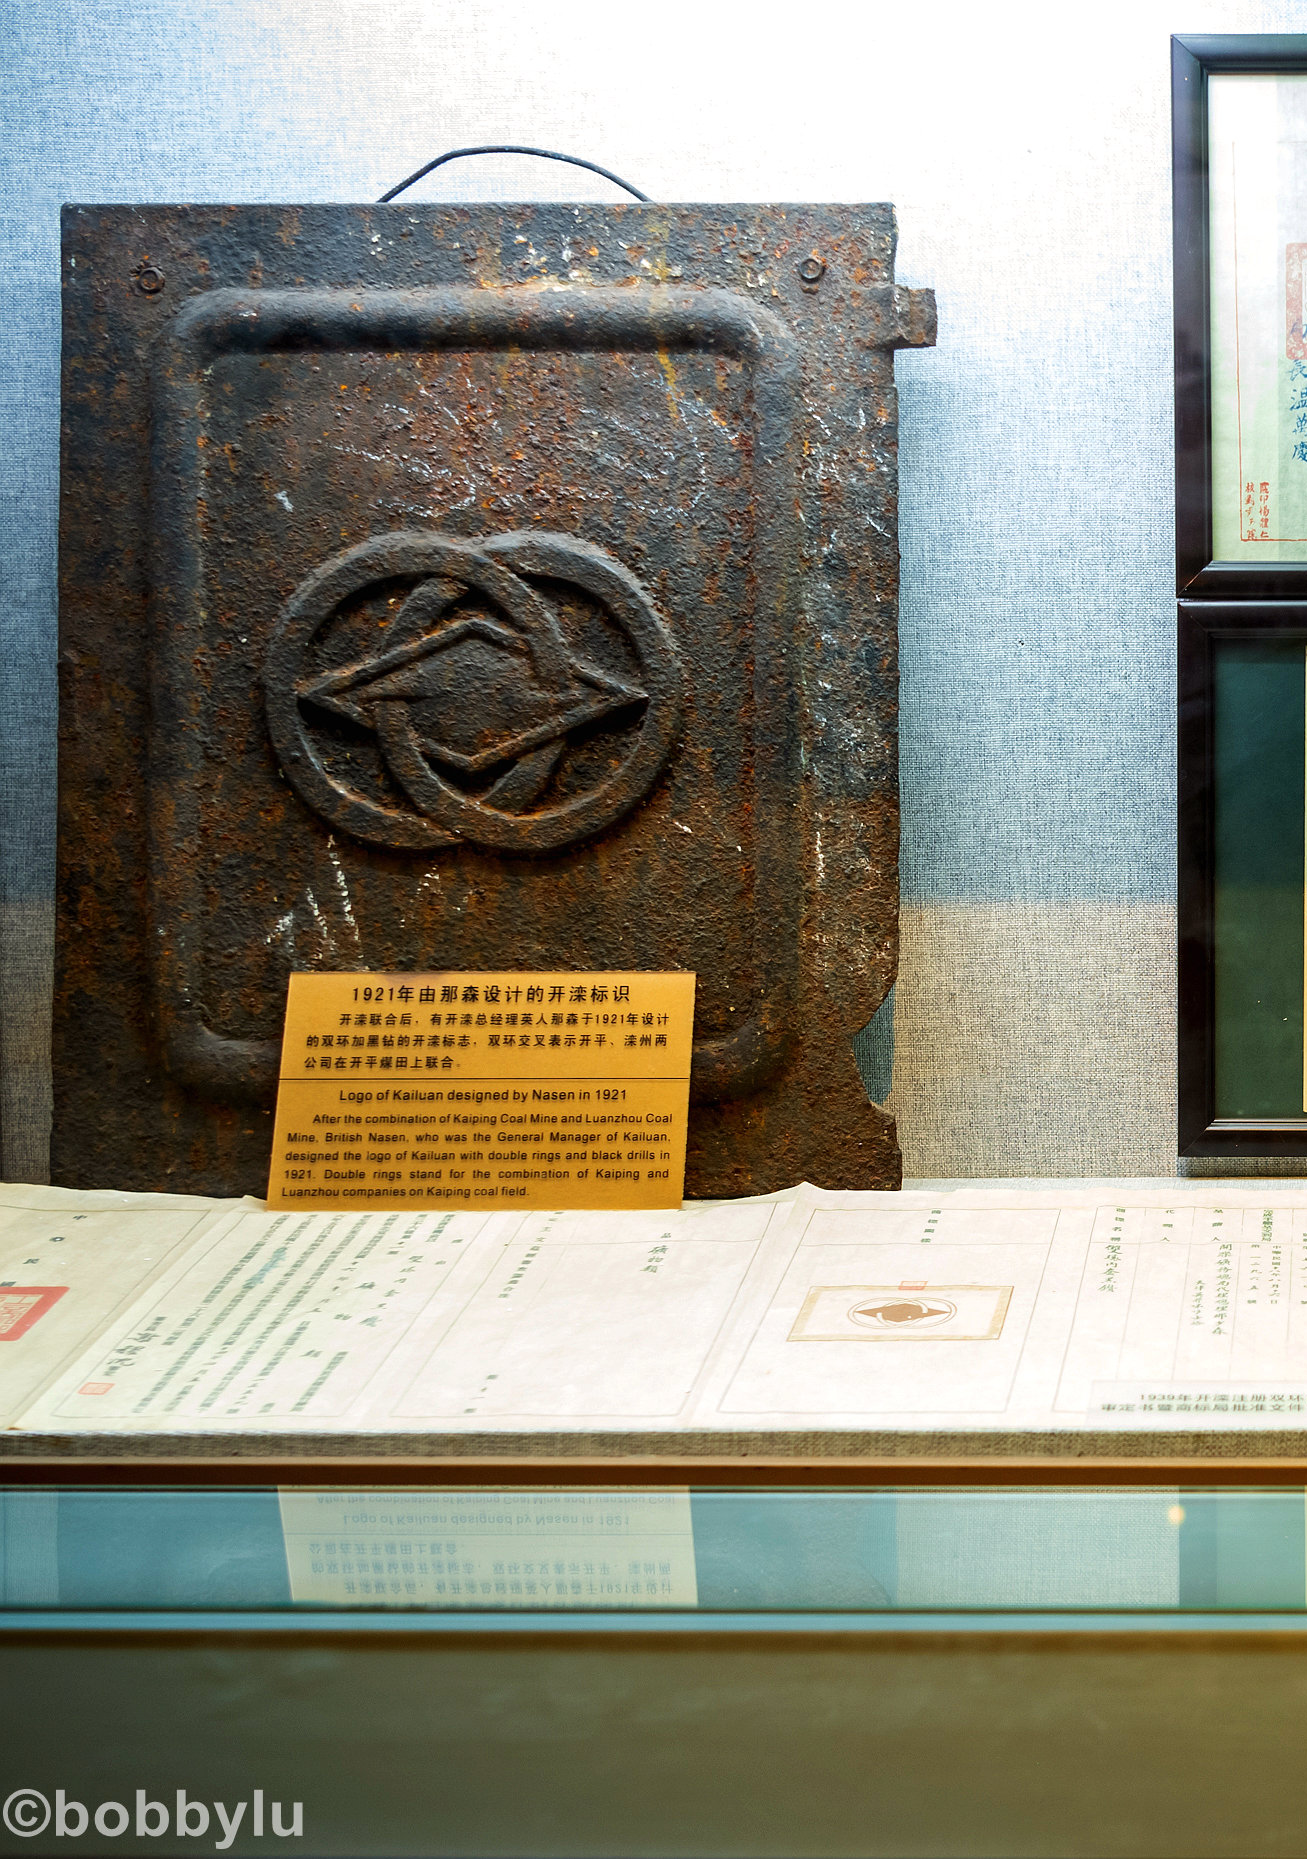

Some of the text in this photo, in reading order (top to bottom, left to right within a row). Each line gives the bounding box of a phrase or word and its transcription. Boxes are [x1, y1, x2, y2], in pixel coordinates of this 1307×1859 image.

[352, 984, 631, 1004] 1921年由那森设计的开滦标识
[339, 1088, 627, 1104] Logo of Kailuan designed by Nasen in 1921
[312, 1113, 673, 1127] After the combination of Kaiping Coal Mine and Luanzhou Coal
[324, 1132, 363, 1143] British
[415, 1132, 440, 1143] who
[444, 1134, 468, 1143] was
[473, 1132, 492, 1142] the
[497, 1131, 544, 1142] General
[549, 1131, 602, 1145] Manager
[606, 1131, 619, 1142] of
[285, 1150, 670, 1163] designed the logo of Kailuan with double rings and black drills in
[323, 1169, 366, 1180] Double
[372, 1171, 403, 1181] rings
[409, 1169, 442, 1180] stand
[449, 1168, 466, 1179] for
[472, 1169, 491, 1179] the
[498, 1168, 570, 1179] combination
[576, 1168, 590, 1179] of
[595, 1168, 640, 1181] Kaiping
[647, 1168, 669, 1179] and
[281, 1186, 530, 1199] Luanzhou companies on Kaiping coal field.
